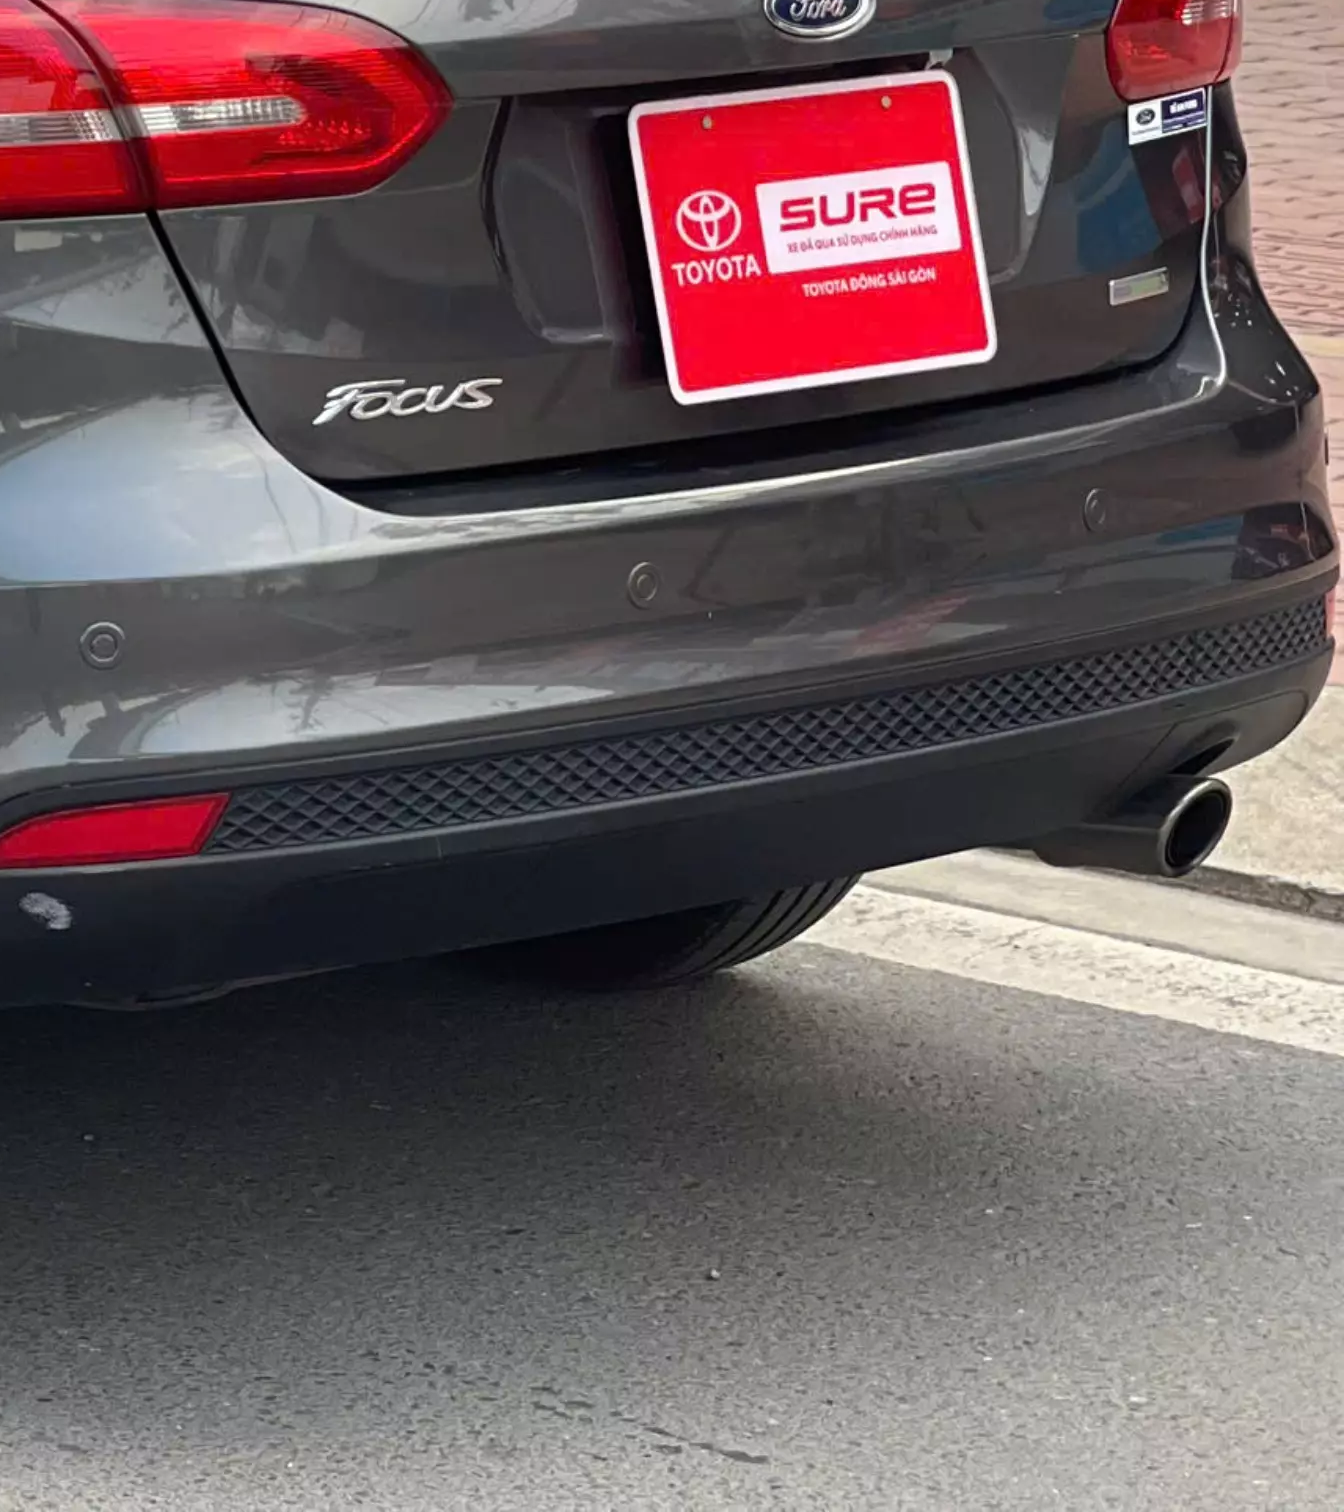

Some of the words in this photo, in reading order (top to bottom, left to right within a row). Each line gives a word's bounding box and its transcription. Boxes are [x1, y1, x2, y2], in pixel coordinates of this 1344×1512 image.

[815, 237, 836, 251] QUA
[671, 253, 762, 287] TOYOTA
[802, 279, 849, 298] TOYOTA
[850, 272, 887, 293] ĐÔNG
[888, 269, 907, 288] SÀI
[908, 265, 937, 284] GÒN
